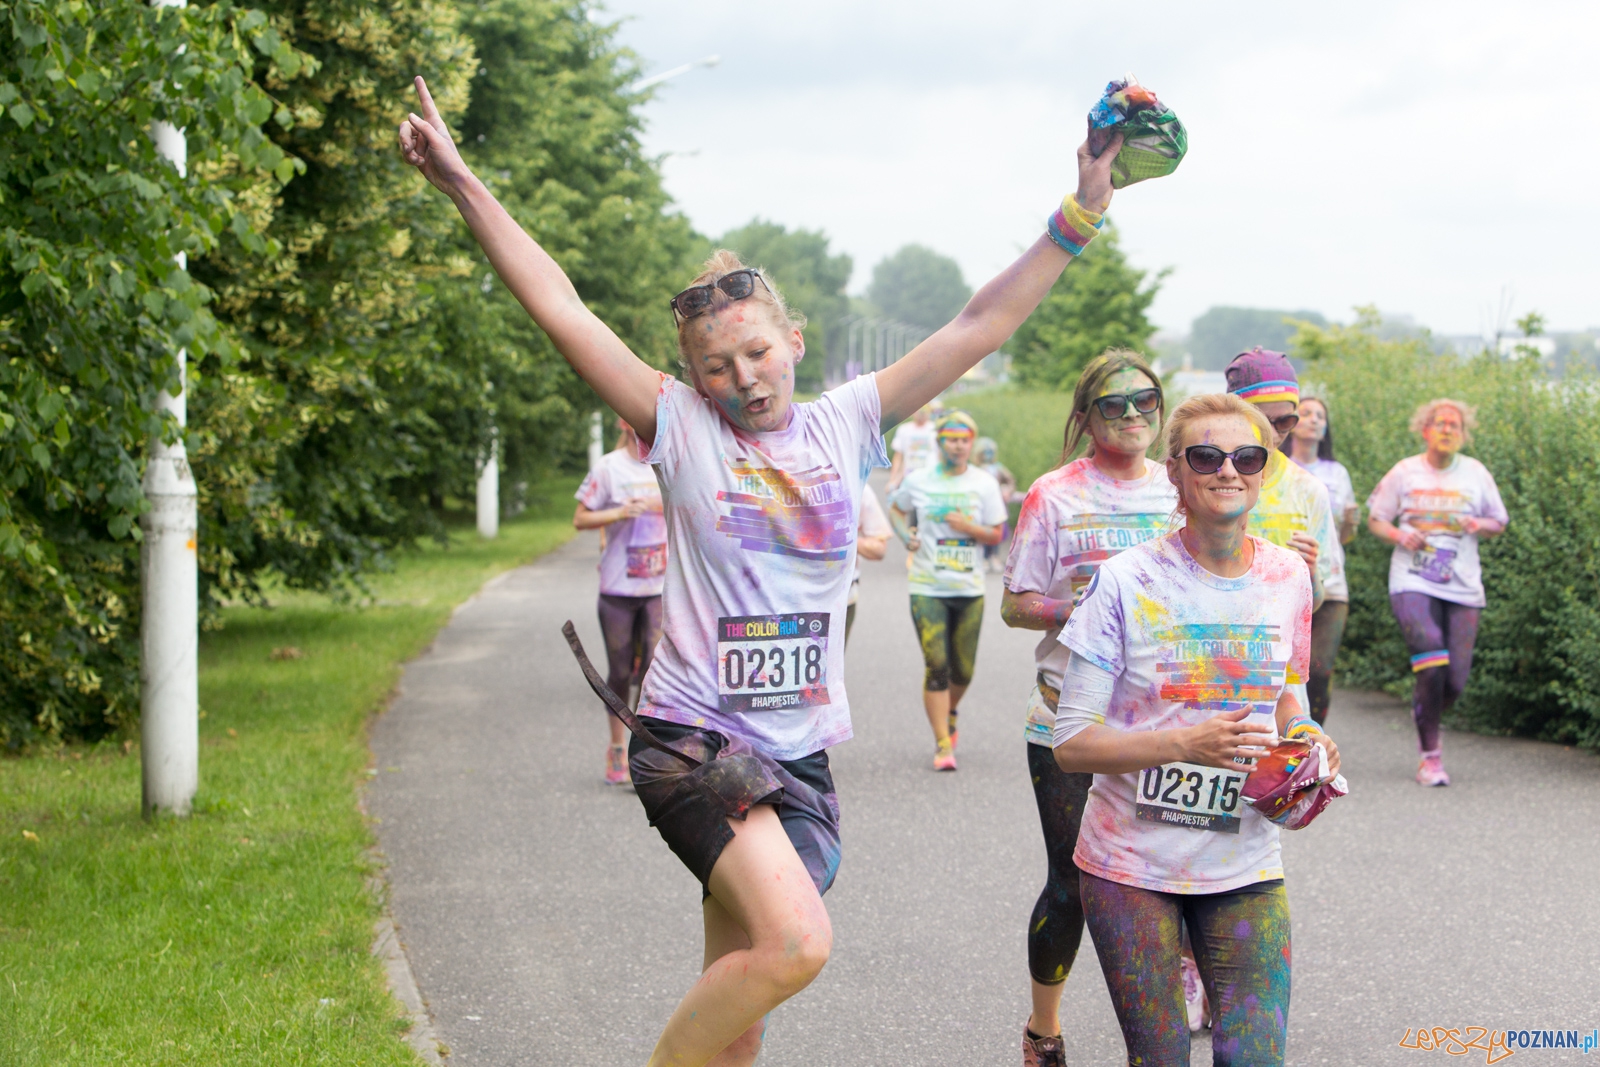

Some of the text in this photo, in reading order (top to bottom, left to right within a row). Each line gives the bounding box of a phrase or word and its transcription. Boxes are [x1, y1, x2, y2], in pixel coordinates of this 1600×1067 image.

[1074, 530, 1105, 551] THE
[725, 623, 746, 638] THE
[746, 621, 779, 637] COLOR
[1200, 640, 1247, 660] COLOR
[1247, 640, 1274, 661] RUN
[725, 644, 822, 690] 02318
[751, 694, 801, 708] #HAPPIEST5K
[1142, 765, 1242, 813] 02315
[1161, 810, 1212, 827] #HAPPIEST5K
